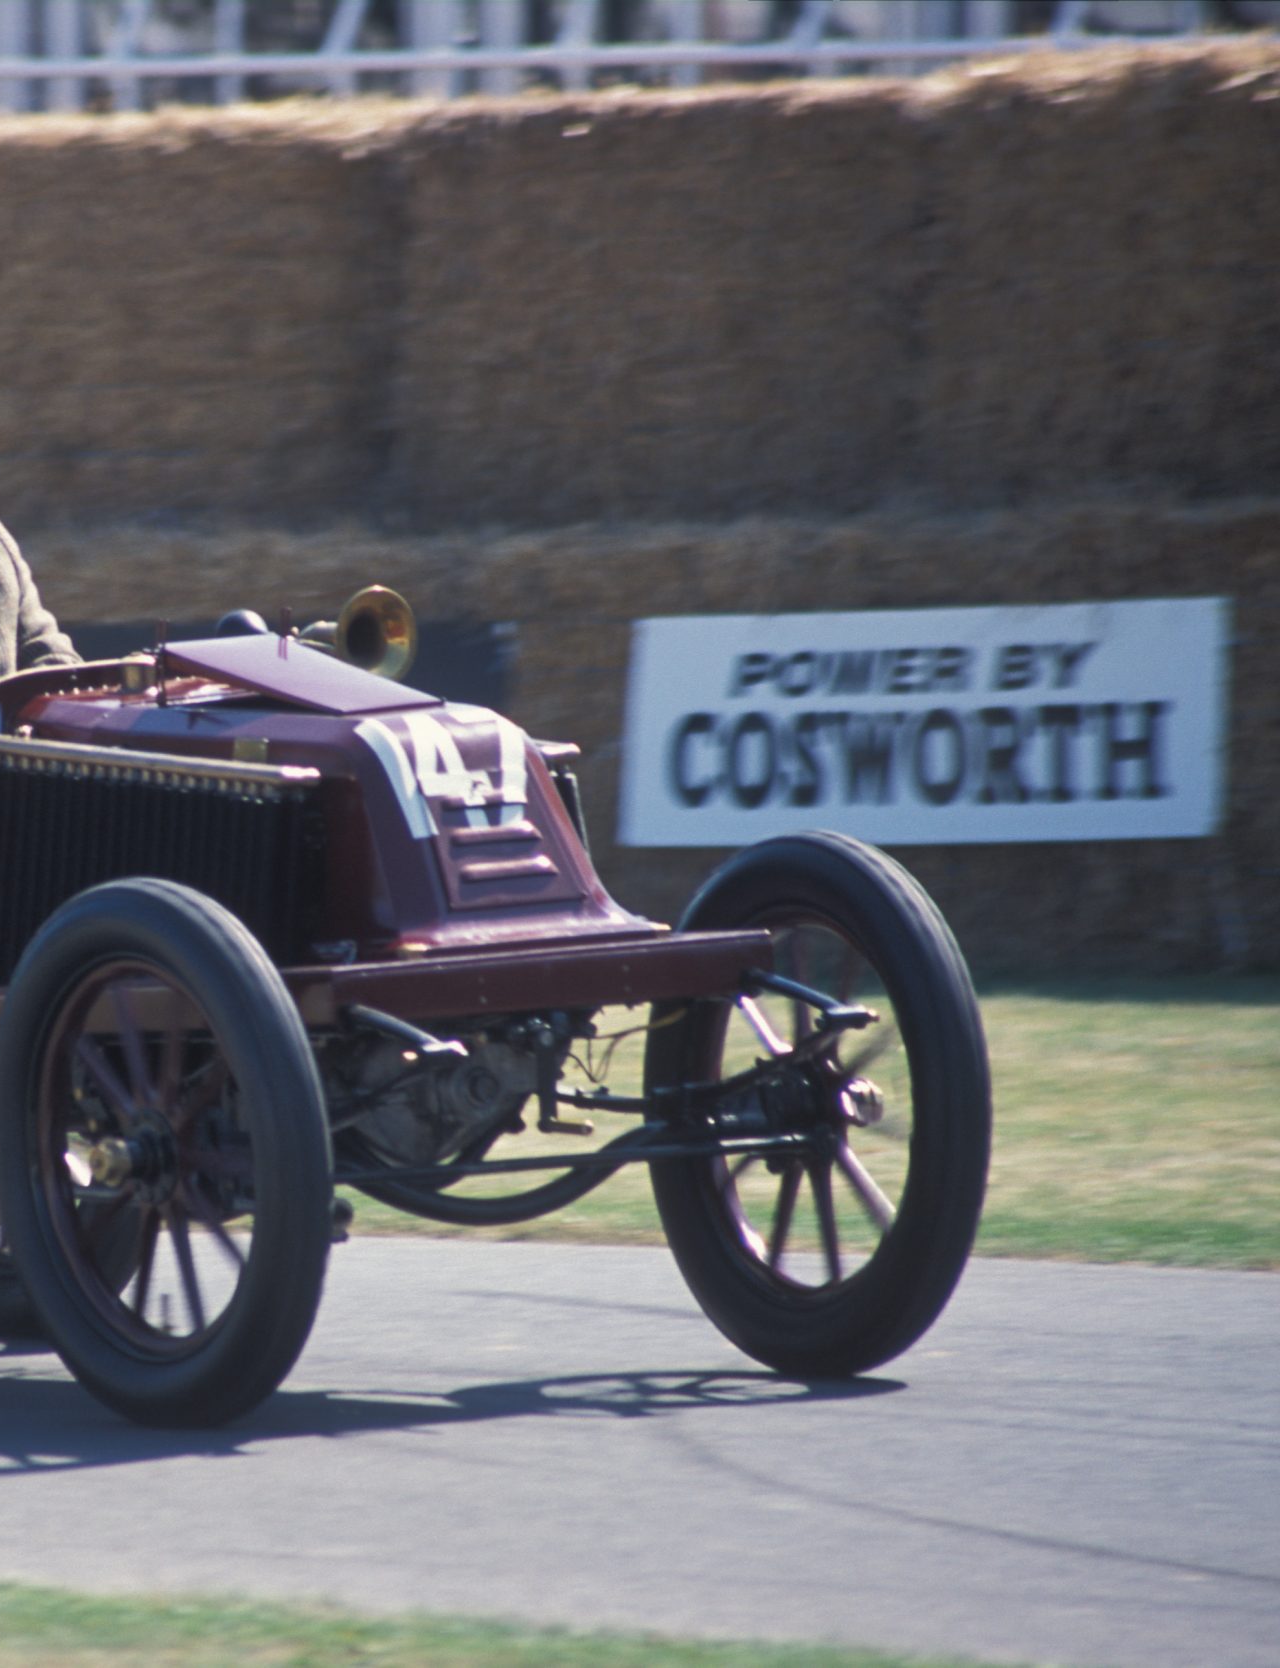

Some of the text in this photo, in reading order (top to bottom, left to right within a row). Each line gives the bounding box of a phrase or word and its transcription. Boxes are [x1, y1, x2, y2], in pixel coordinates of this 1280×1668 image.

[727, 641, 1099, 698] POWER BY
[669, 700, 1173, 809] COSWORTH
